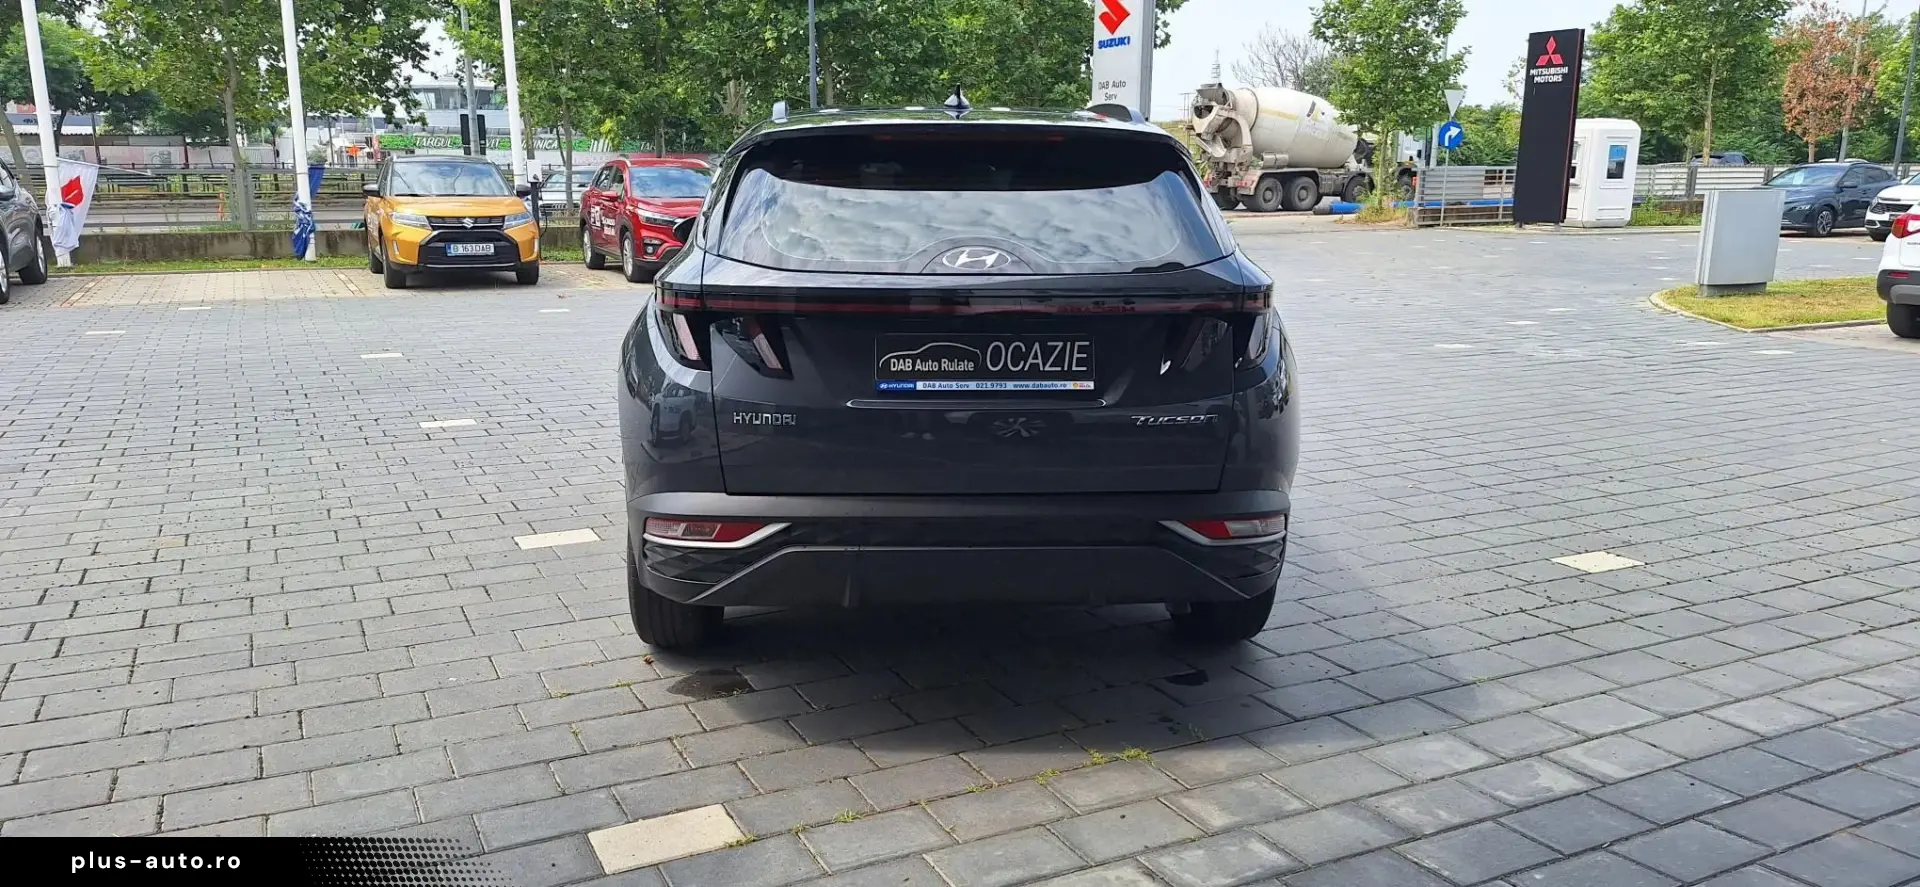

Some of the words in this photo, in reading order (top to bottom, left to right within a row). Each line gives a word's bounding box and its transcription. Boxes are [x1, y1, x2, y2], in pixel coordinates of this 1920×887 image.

[1098, 36, 1131, 49] SUZUKI
[1530, 66, 1568, 76] MITSUBISHI
[1533, 75, 1563, 84] MOTORS
[1098, 81, 1109, 90] DAB
[1112, 80, 1126, 88] Auto
[1104, 93, 1117, 101] Serv
[452, 244, 459, 252] B
[475, 244, 491, 252] DAB
[986, 341, 1090, 371] OCAZIE
[890, 358, 913, 371] DAB
[915, 358, 939, 371] Auto
[941, 358, 974, 371] Rulate
[733, 412, 796, 425] HYUNDAI
